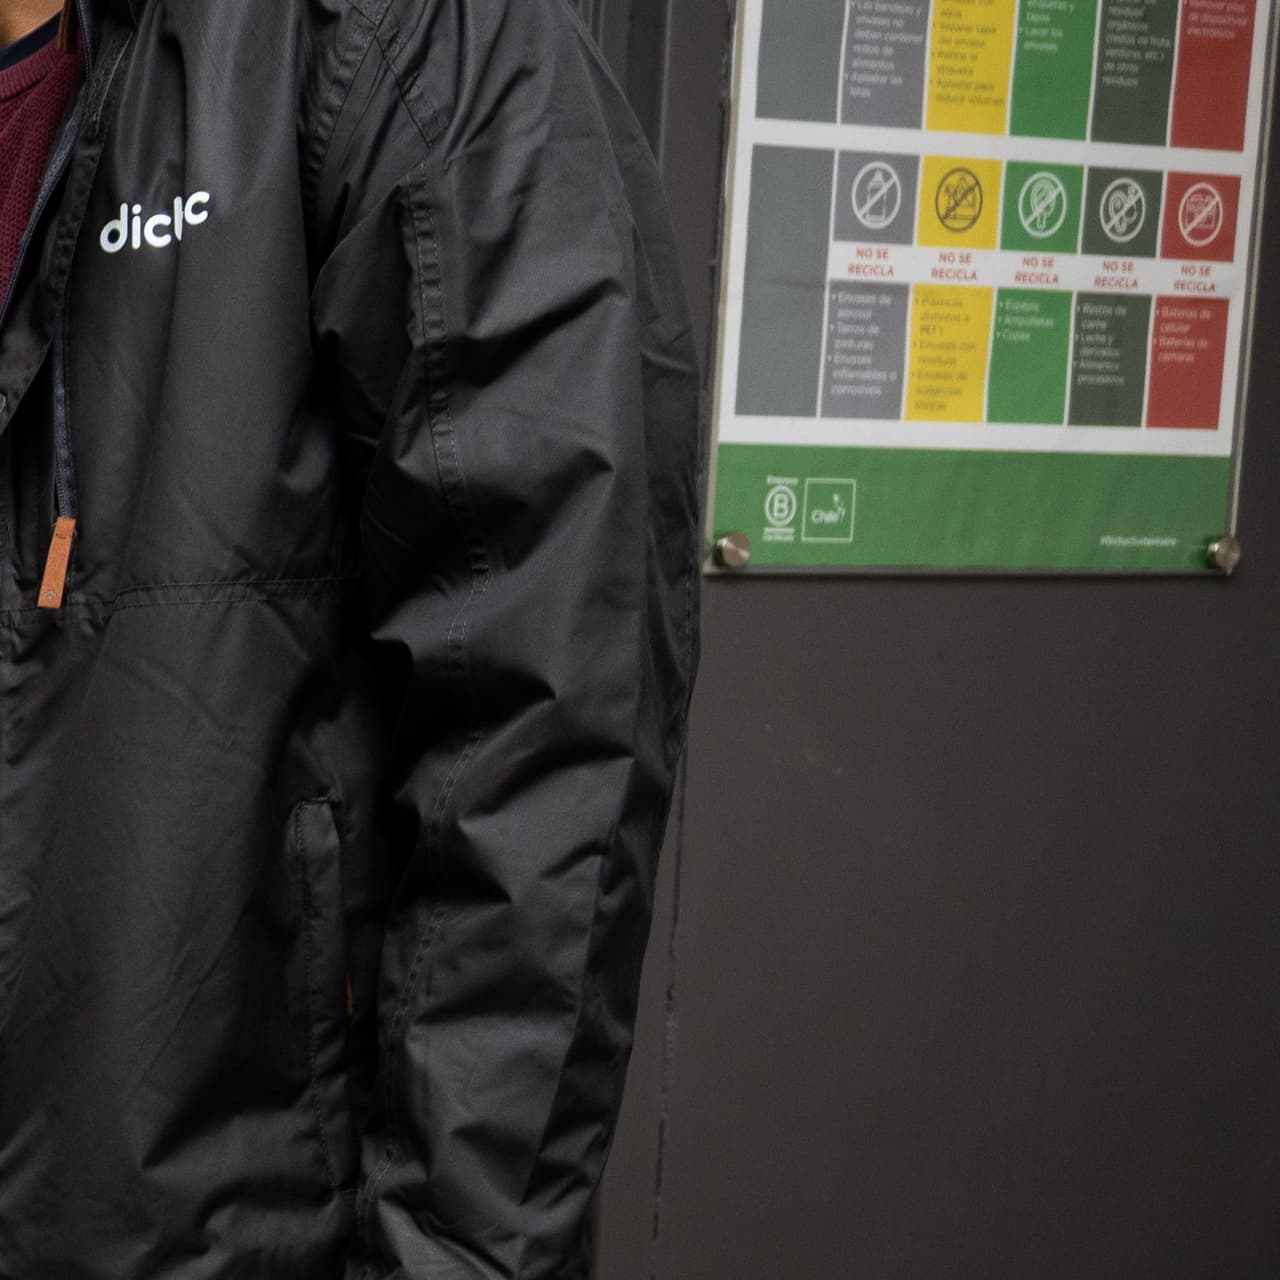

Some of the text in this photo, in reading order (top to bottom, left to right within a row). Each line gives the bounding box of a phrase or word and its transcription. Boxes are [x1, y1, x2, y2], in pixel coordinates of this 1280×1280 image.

[856, 247, 888, 261] NO SE
[939, 252, 972, 264] NO SE
[1022, 256, 1054, 269] NO SE
[1103, 261, 1134, 273] NO SE
[847, 263, 894, 277] RECICLA
[931, 268, 977, 281] RECICLA
[1181, 265, 1211, 277] NO SE
[1014, 272, 1059, 285] RECICLA
[1094, 277, 1138, 289] RECICLA
[1173, 280, 1216, 293] RECICLA
